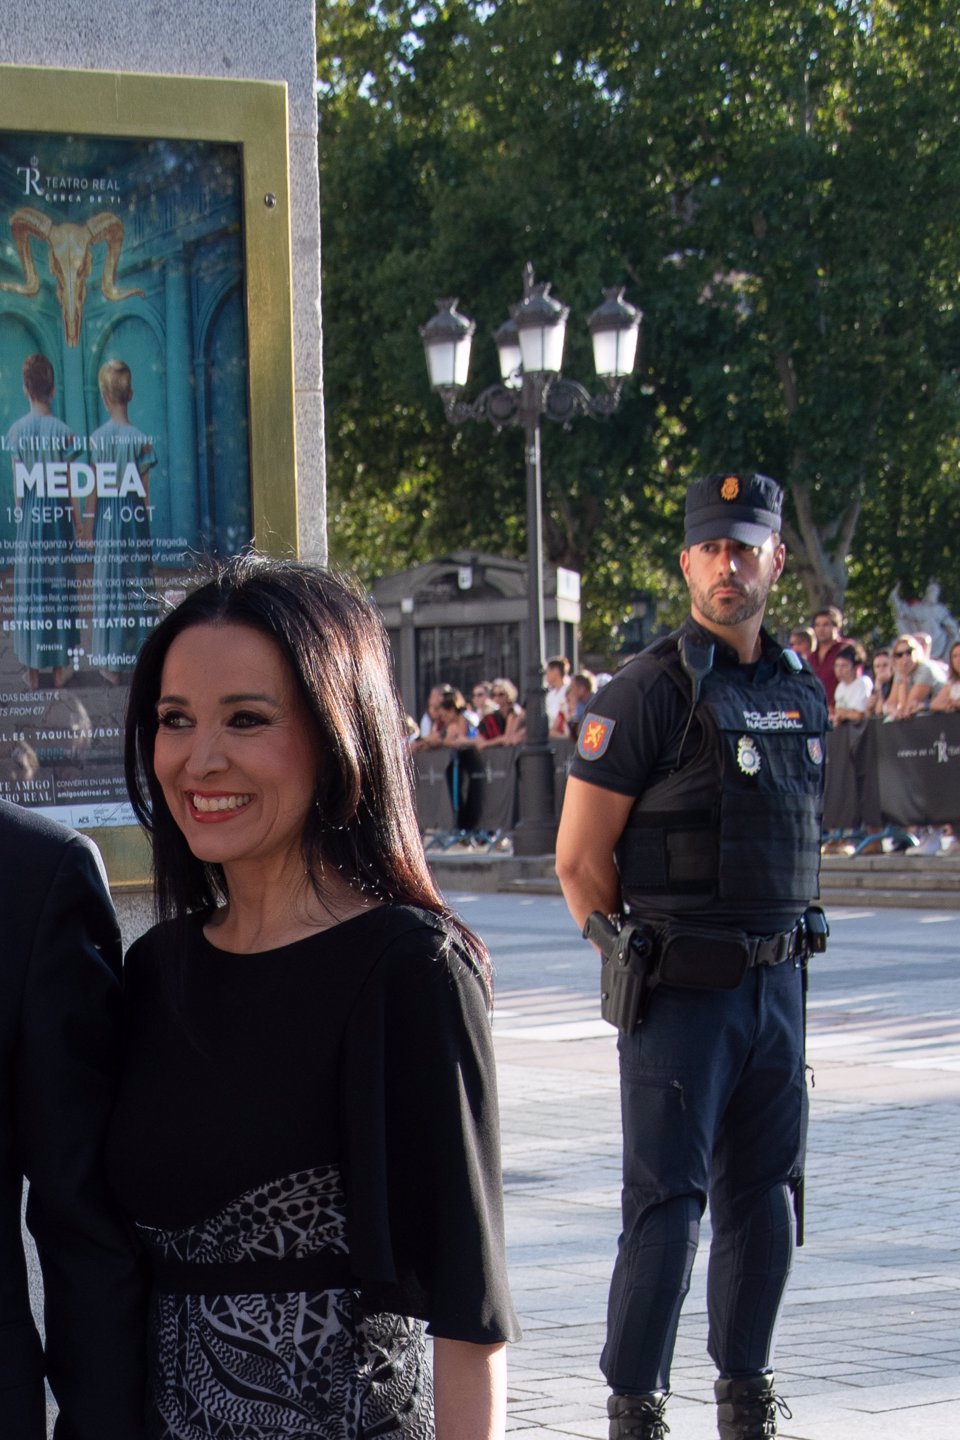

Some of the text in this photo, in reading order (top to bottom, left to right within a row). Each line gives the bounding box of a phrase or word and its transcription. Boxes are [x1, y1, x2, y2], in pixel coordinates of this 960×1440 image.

[46, 177, 88, 190] TEATRO
[93, 178, 120, 191] REAL
[45, 193, 81, 203] CERCA
[90, 195, 102, 204] DE
[1, 436, 13, 450] L.
[19, 436, 105, 450] CHERUBINI
[15, 462, 146, 498] MEDEA
[6, 507, 23, 524] 19
[31, 507, 74, 524] SEPT
[103, 507, 113, 522] 4
[120, 506, 156, 523] OCT
[4, 539, 27, 550] busca
[29, 540, 67, 552] venganza
[69, 541, 74, 551] y
[75, 538, 126, 550] desencadena
[128, 537, 135, 548] la
[137, 539, 154, 551] peor
[156, 538, 188, 550] tragedia
[29, 556, 59, 567] revenge
[131, 552, 150, 562] chain
[152, 552, 160, 562] of
[3, 616, 160, 631] ESTRENO EN EL TEATRO REA
[36, 643, 63, 651] Patrocina
[86, 652, 138, 666] Telefónica
[20, 692, 44, 702] DESDE
[9, 706, 32, 717] FROM
[33, 705, 45, 716] €17
[746, 719, 803, 730] NACIONAL
[35, 728, 120, 741] TAQUILLAS/BOX
[16, 780, 50, 792] AMIGO
[89, 778, 99, 787] EN
[100, 777, 111, 787] UNA
[23, 791, 52, 803] REAL
[57, 789, 110, 799] amigosdelreal.es
